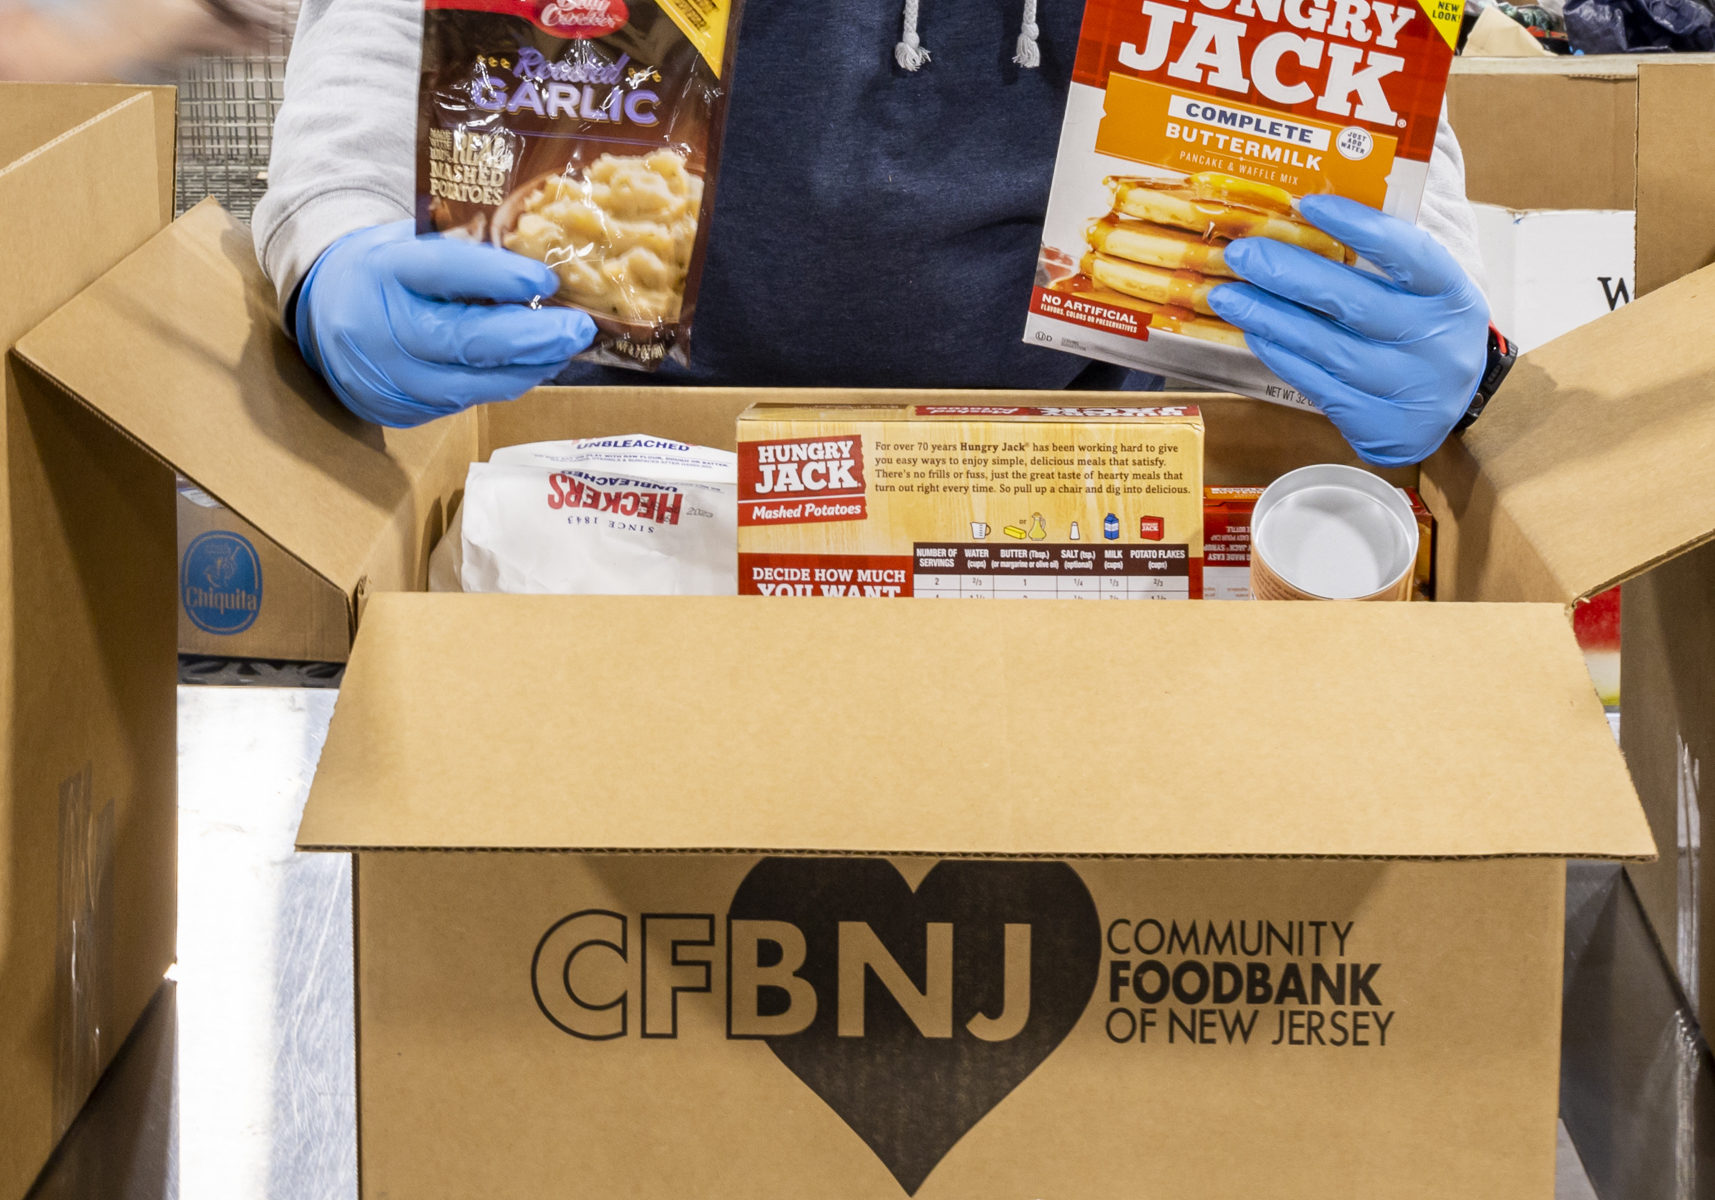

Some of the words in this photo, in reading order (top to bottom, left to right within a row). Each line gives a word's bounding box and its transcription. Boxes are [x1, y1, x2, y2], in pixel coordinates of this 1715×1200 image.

[1438, 1, 1460, 12] NEW
[1432, 10, 1461, 24] LOOK!
[472, 76, 660, 127] GARLIC
[1186, 103, 1313, 144] COMPLETE
[1347, 131, 1367, 143] JUST
[1347, 139, 1363, 147] ADD
[1166, 122, 1323, 171] BUTTERMILK
[1341, 141, 1365, 155] WATER
[430, 160, 505, 187] MASHED
[1180, 151, 1223, 168] PANCAKE
[1227, 161, 1234, 171] &
[1239, 164, 1276, 180] WAFFLE
[1280, 173, 1299, 186] MIX
[430, 178, 503, 206] POTATOES
[1042, 293, 1061, 306] NO
[1064, 300, 1137, 324] ARTIFICIAL
[1066, 310, 1086, 321] COLORS
[1095, 317, 1137, 333] PRESERVATIVES
[1266, 385, 1282, 398] NET
[1283, 389, 1295, 401] WT
[1296, 393, 1305, 404] 32
[577, 439, 690, 452] UNBLEACHED
[758, 440, 853, 463] HUNGRY
[875, 442, 891, 451] For
[917, 442, 928, 451] 70
[931, 444, 957, 453] years
[960, 442, 999, 453] Hungry
[1033, 443, 1049, 452] has
[1052, 443, 1075, 452] been
[1078, 443, 1118, 454] working
[1120, 444, 1143, 452] hard
[1145, 444, 1155, 452] to
[1158, 444, 1178, 454] give
[875, 457, 893, 467] you
[896, 457, 918, 467] easy
[921, 457, 946, 467] ways
[949, 457, 959, 465] to
[962, 457, 989, 467] enjoy
[991, 457, 1027, 467] simple,
[1030, 457, 1074, 466] delicious
[1077, 457, 1106, 466] meals
[1108, 457, 1129, 466] that
[1132, 457, 1166, 468] satisfy.
[561, 470, 677, 493] UNBLEACHED
[928, 470, 950, 479] frills
[966, 470, 988, 480] fuss,
[991, 470, 1009, 481] just
[1012, 470, 1027, 479] the
[1029, 471, 1055, 481] great
[1057, 471, 1081, 480] taste
[1084, 470, 1095, 480] of
[1097, 470, 1129, 481] hearty
[1132, 470, 1160, 480] meals
[1163, 471, 1183, 480] that
[875, 484, 895, 492] turn
[898, 484, 914, 492] out
[917, 483, 939, 494] right
[942, 485, 969, 494] every
[972, 484, 996, 493] time.
[999, 485, 1011, 493] So
[1014, 484, 1032, 495] pull
[1035, 486, 1047, 495] up
[1058, 484, 1082, 493] chair
[1086, 484, 1103, 494] and
[1105, 485, 1120, 495] dig
[1124, 485, 1142, 494] into
[1145, 484, 1190, 494] delicious.
[547, 472, 683, 525] HECKERS
[752, 503, 801, 520] Mashed
[804, 502, 861, 518] Potatoes
[567, 515, 598, 525] 1843
[608, 520, 655, 534] SINCE
[916, 549, 945, 557] NUMBER
[948, 549, 958, 557] OF
[964, 549, 989, 558] WATER
[1000, 550, 1027, 558] BUTTER
[1029, 550, 1050, 560] (Tbsp.)
[1061, 550, 1078, 558] SALT
[1080, 550, 1096, 560] (tsp.)
[1130, 551, 1157, 559] POTATO
[1159, 551, 1185, 559] FLAKES
[919, 558, 954, 567] SERVINGS
[968, 560, 986, 569] (cups)
[1000, 561, 1027, 569] margarine
[1064, 561, 1093, 570] (optional)
[1104, 561, 1123, 570] (cups)
[1148, 561, 1167, 570] (cups)
[753, 568, 810, 581] DECIDE
[814, 569, 853, 581] HOW
[857, 570, 906, 583] MUCH
[757, 583, 813, 597] YOU
[820, 585, 901, 598] WANT
[185, 586, 257, 614] Chiquita
[1105, 917, 1355, 959] COMMUNITY
[530, 907, 1032, 1042] CFBNJ
[1108, 960, 1383, 1007] FOODBANK
[1105, 1008, 1156, 1046] OF
[1169, 1009, 1259, 1046] NEW
[1272, 1010, 1396, 1048] JERSEY
